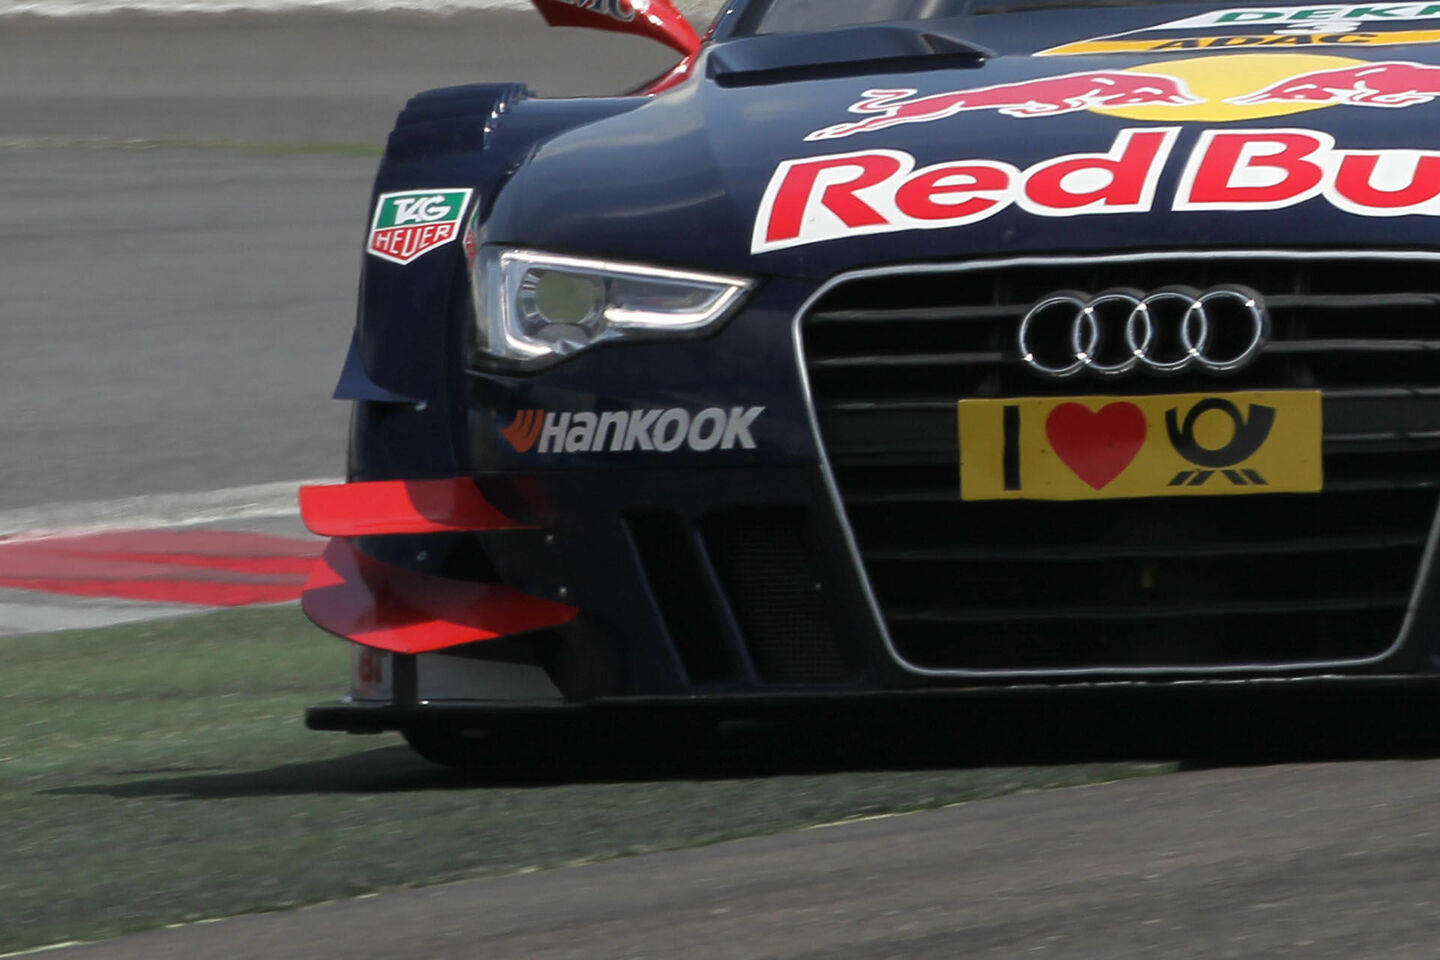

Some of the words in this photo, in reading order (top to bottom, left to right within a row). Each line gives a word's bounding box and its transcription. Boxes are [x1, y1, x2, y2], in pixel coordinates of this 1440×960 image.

[1146, 33, 1380, 52] ADAC
[752, 127, 1181, 254] Red
[393, 195, 452, 225] TAG
[375, 224, 452, 257] HEUER
